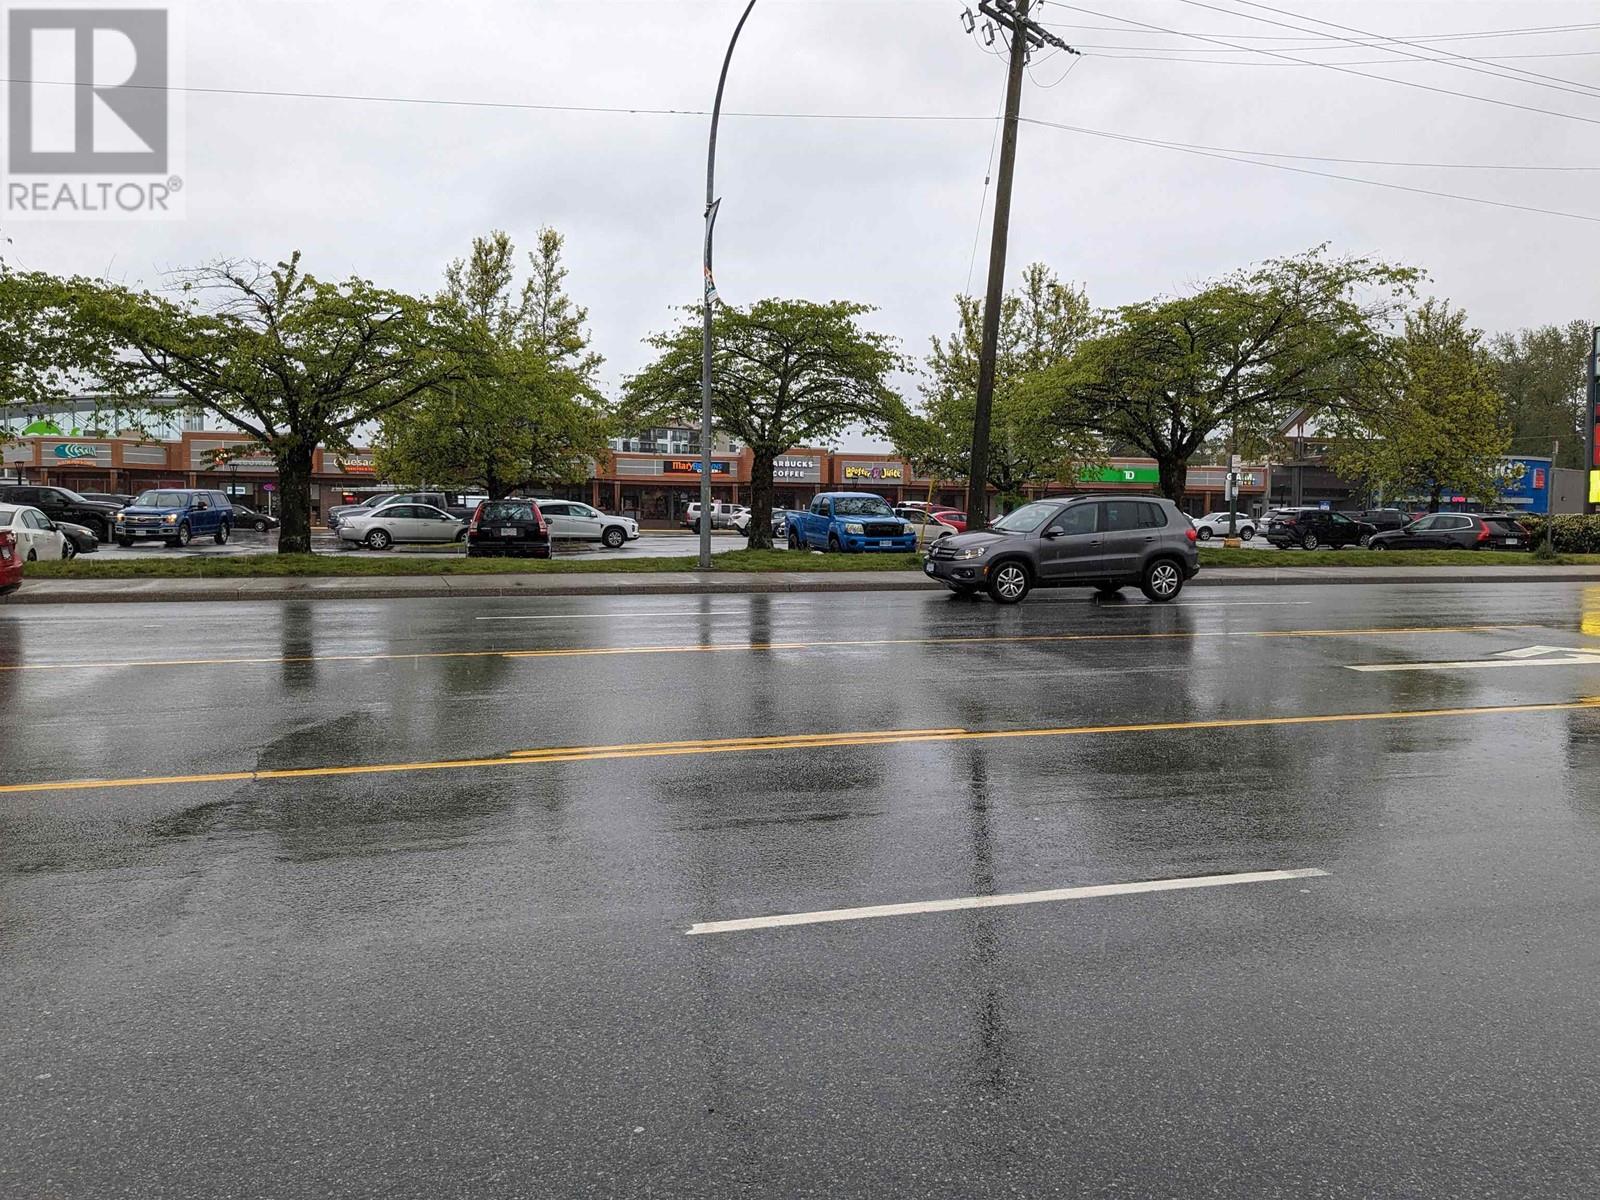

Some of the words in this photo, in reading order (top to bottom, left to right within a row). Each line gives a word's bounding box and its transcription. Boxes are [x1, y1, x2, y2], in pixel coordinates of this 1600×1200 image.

[772, 470, 805, 478] COFFEE
[881, 467, 901, 479] Juice
[1123, 470, 1135, 480] TD
